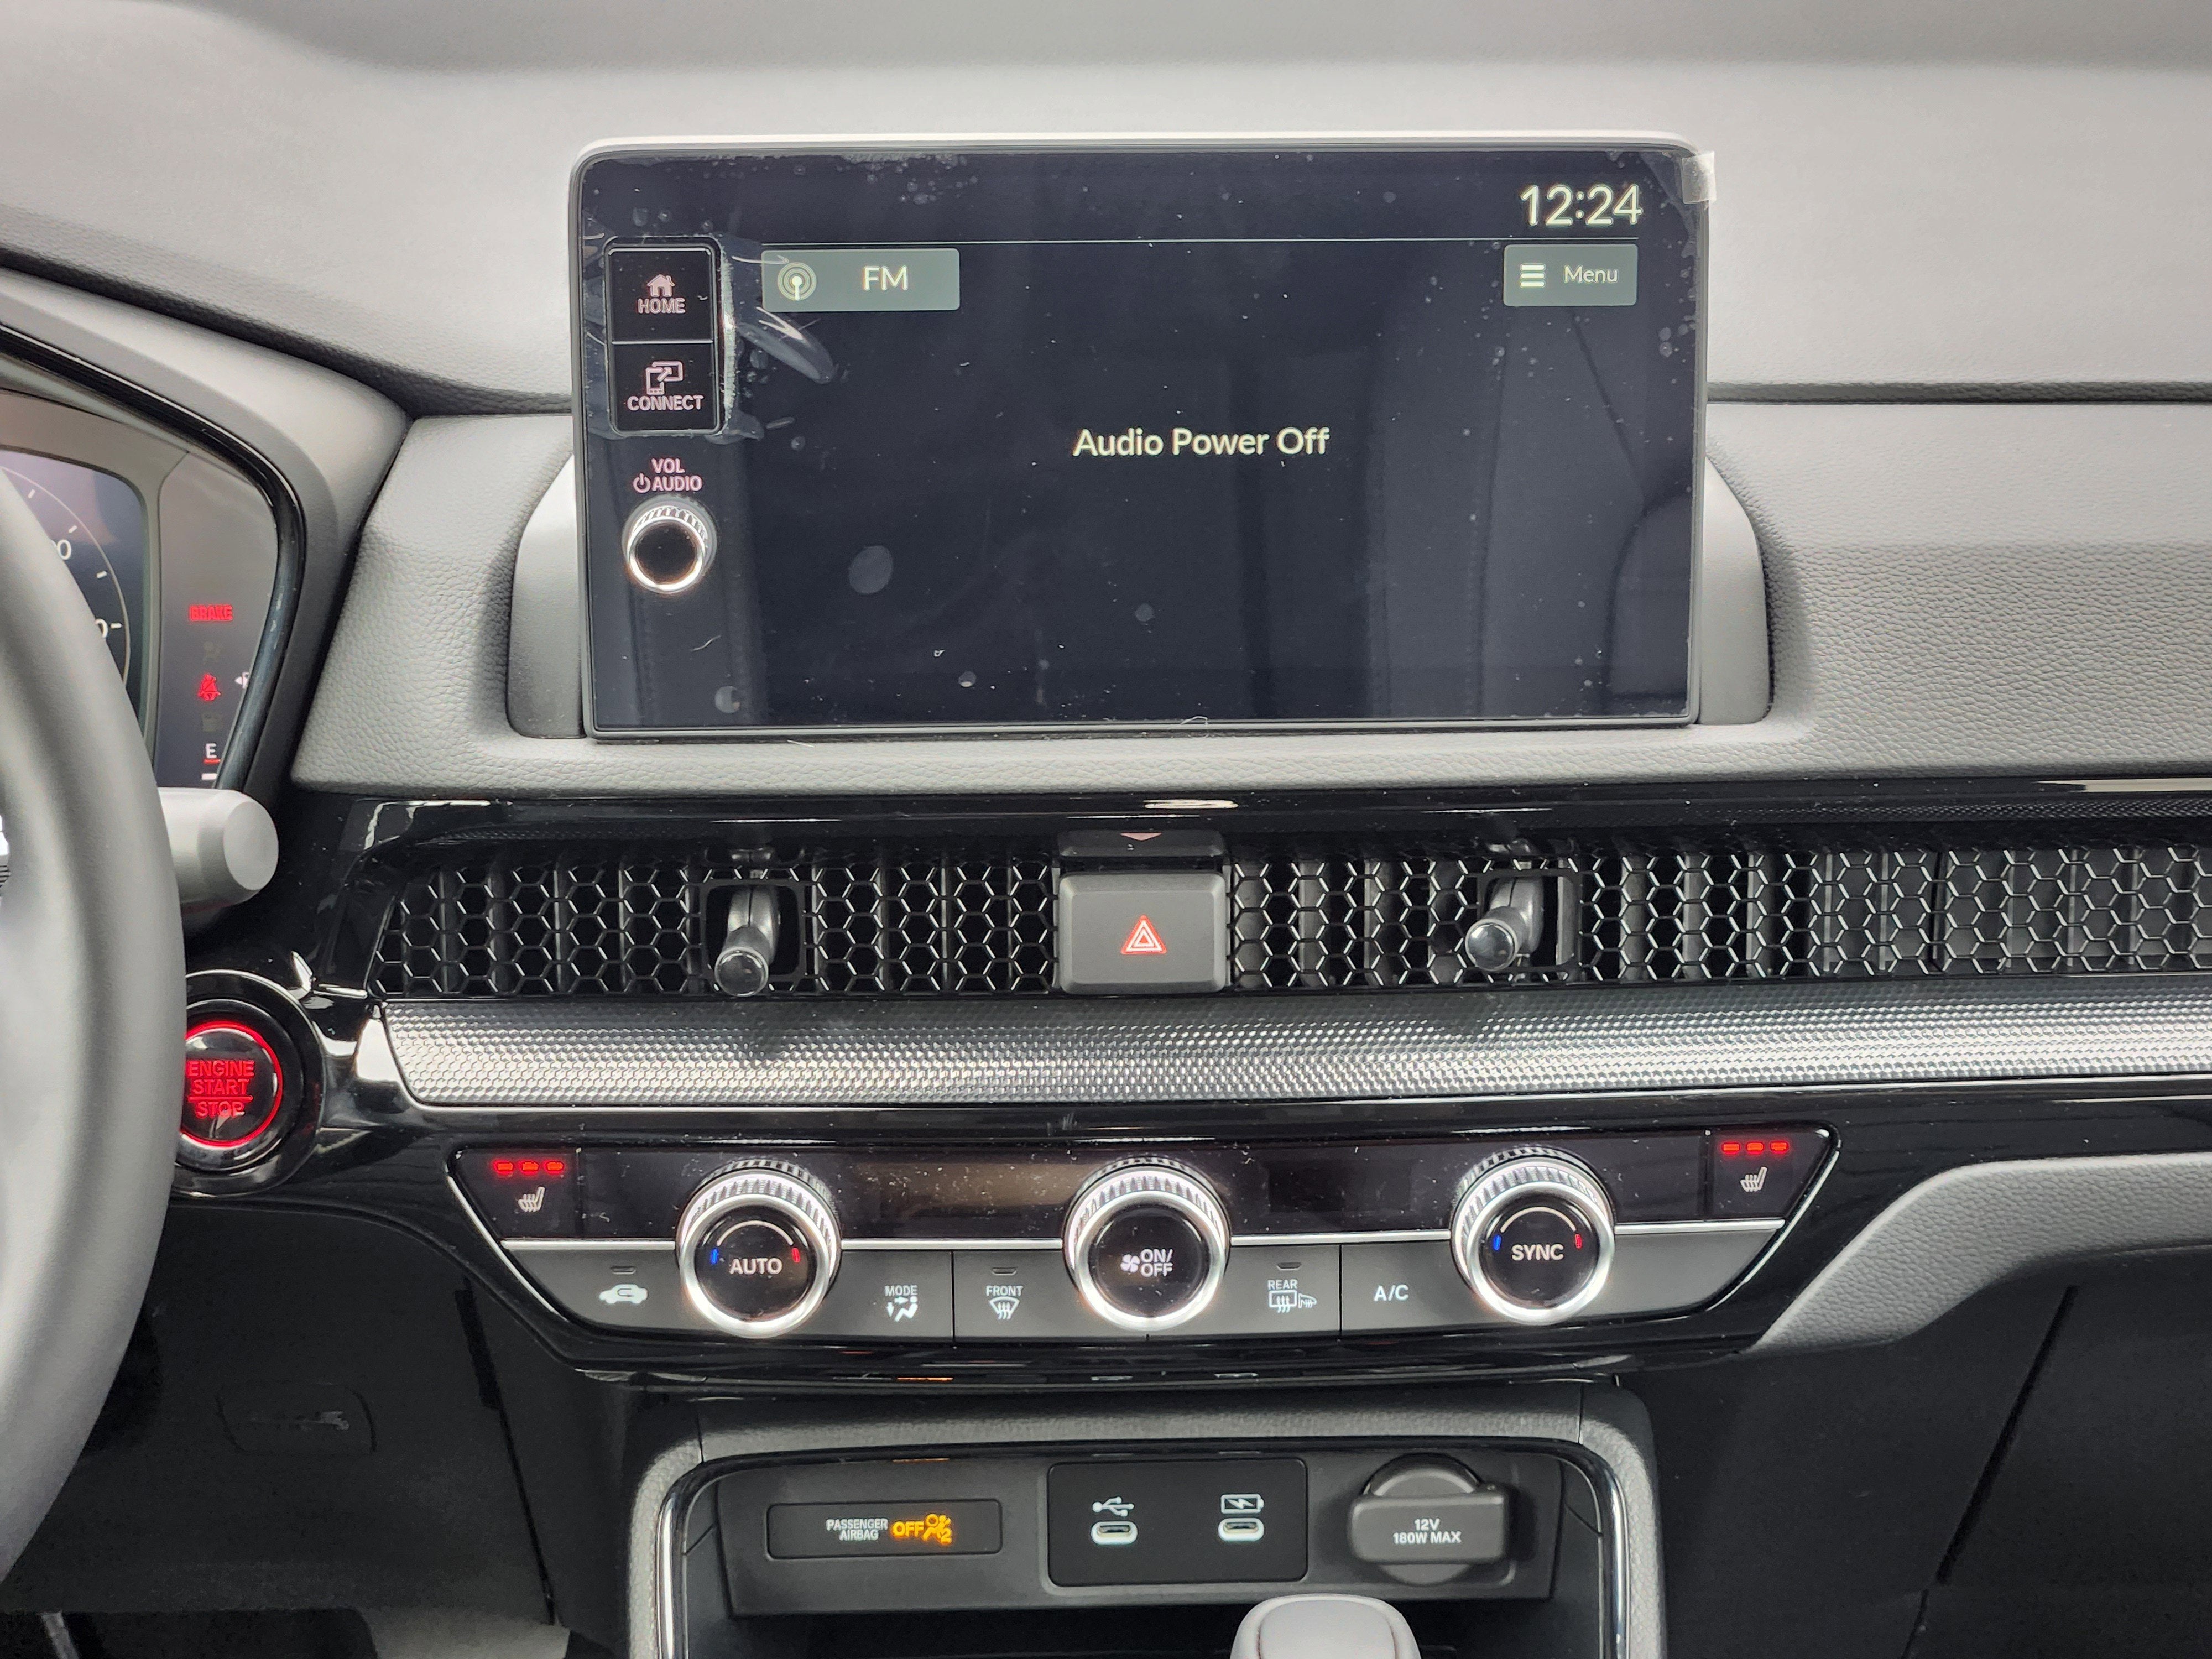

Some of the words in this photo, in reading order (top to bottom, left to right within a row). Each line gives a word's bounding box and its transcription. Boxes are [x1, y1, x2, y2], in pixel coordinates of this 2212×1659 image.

[1521, 184, 1644, 226] 12:24
[863, 265, 909, 291] FM
[1563, 265, 1618, 284] Menu
[638, 298, 686, 314] HOME
[627, 395, 704, 410] CONNECT
[1072, 428, 1164, 456] Audio
[1172, 428, 1270, 455] Power
[1276, 427, 1330, 455] Off
[651, 458, 685, 474] VOL
[651, 476, 702, 491] AUDIO
[190, 604, 233, 621] BRAKE
[205, 743, 217, 758] E
[187, 1060, 255, 1076] ENGINE
[192, 1078, 249, 1094] START
[196, 1101, 245, 1117] STOP
[1140, 1249, 1173, 1263] ON/
[1511, 1244, 1564, 1261] SYNC
[729, 1258, 782, 1275] AUTO
[1140, 1263, 1173, 1277] OFF
[885, 1285, 917, 1296] MODE
[986, 1285, 1024, 1297] FRONT
[1267, 1279, 1298, 1290] REAR
[1374, 1284, 1409, 1302] A/C
[826, 1519, 888, 1531] PASSENGER
[892, 1521, 924, 1537] OFF
[1414, 1518, 1441, 1531] 12V
[839, 1530, 879, 1541] AIRBAG
[1393, 1531, 1427, 1544] 180W
[1430, 1531, 1462, 1543] MAX
